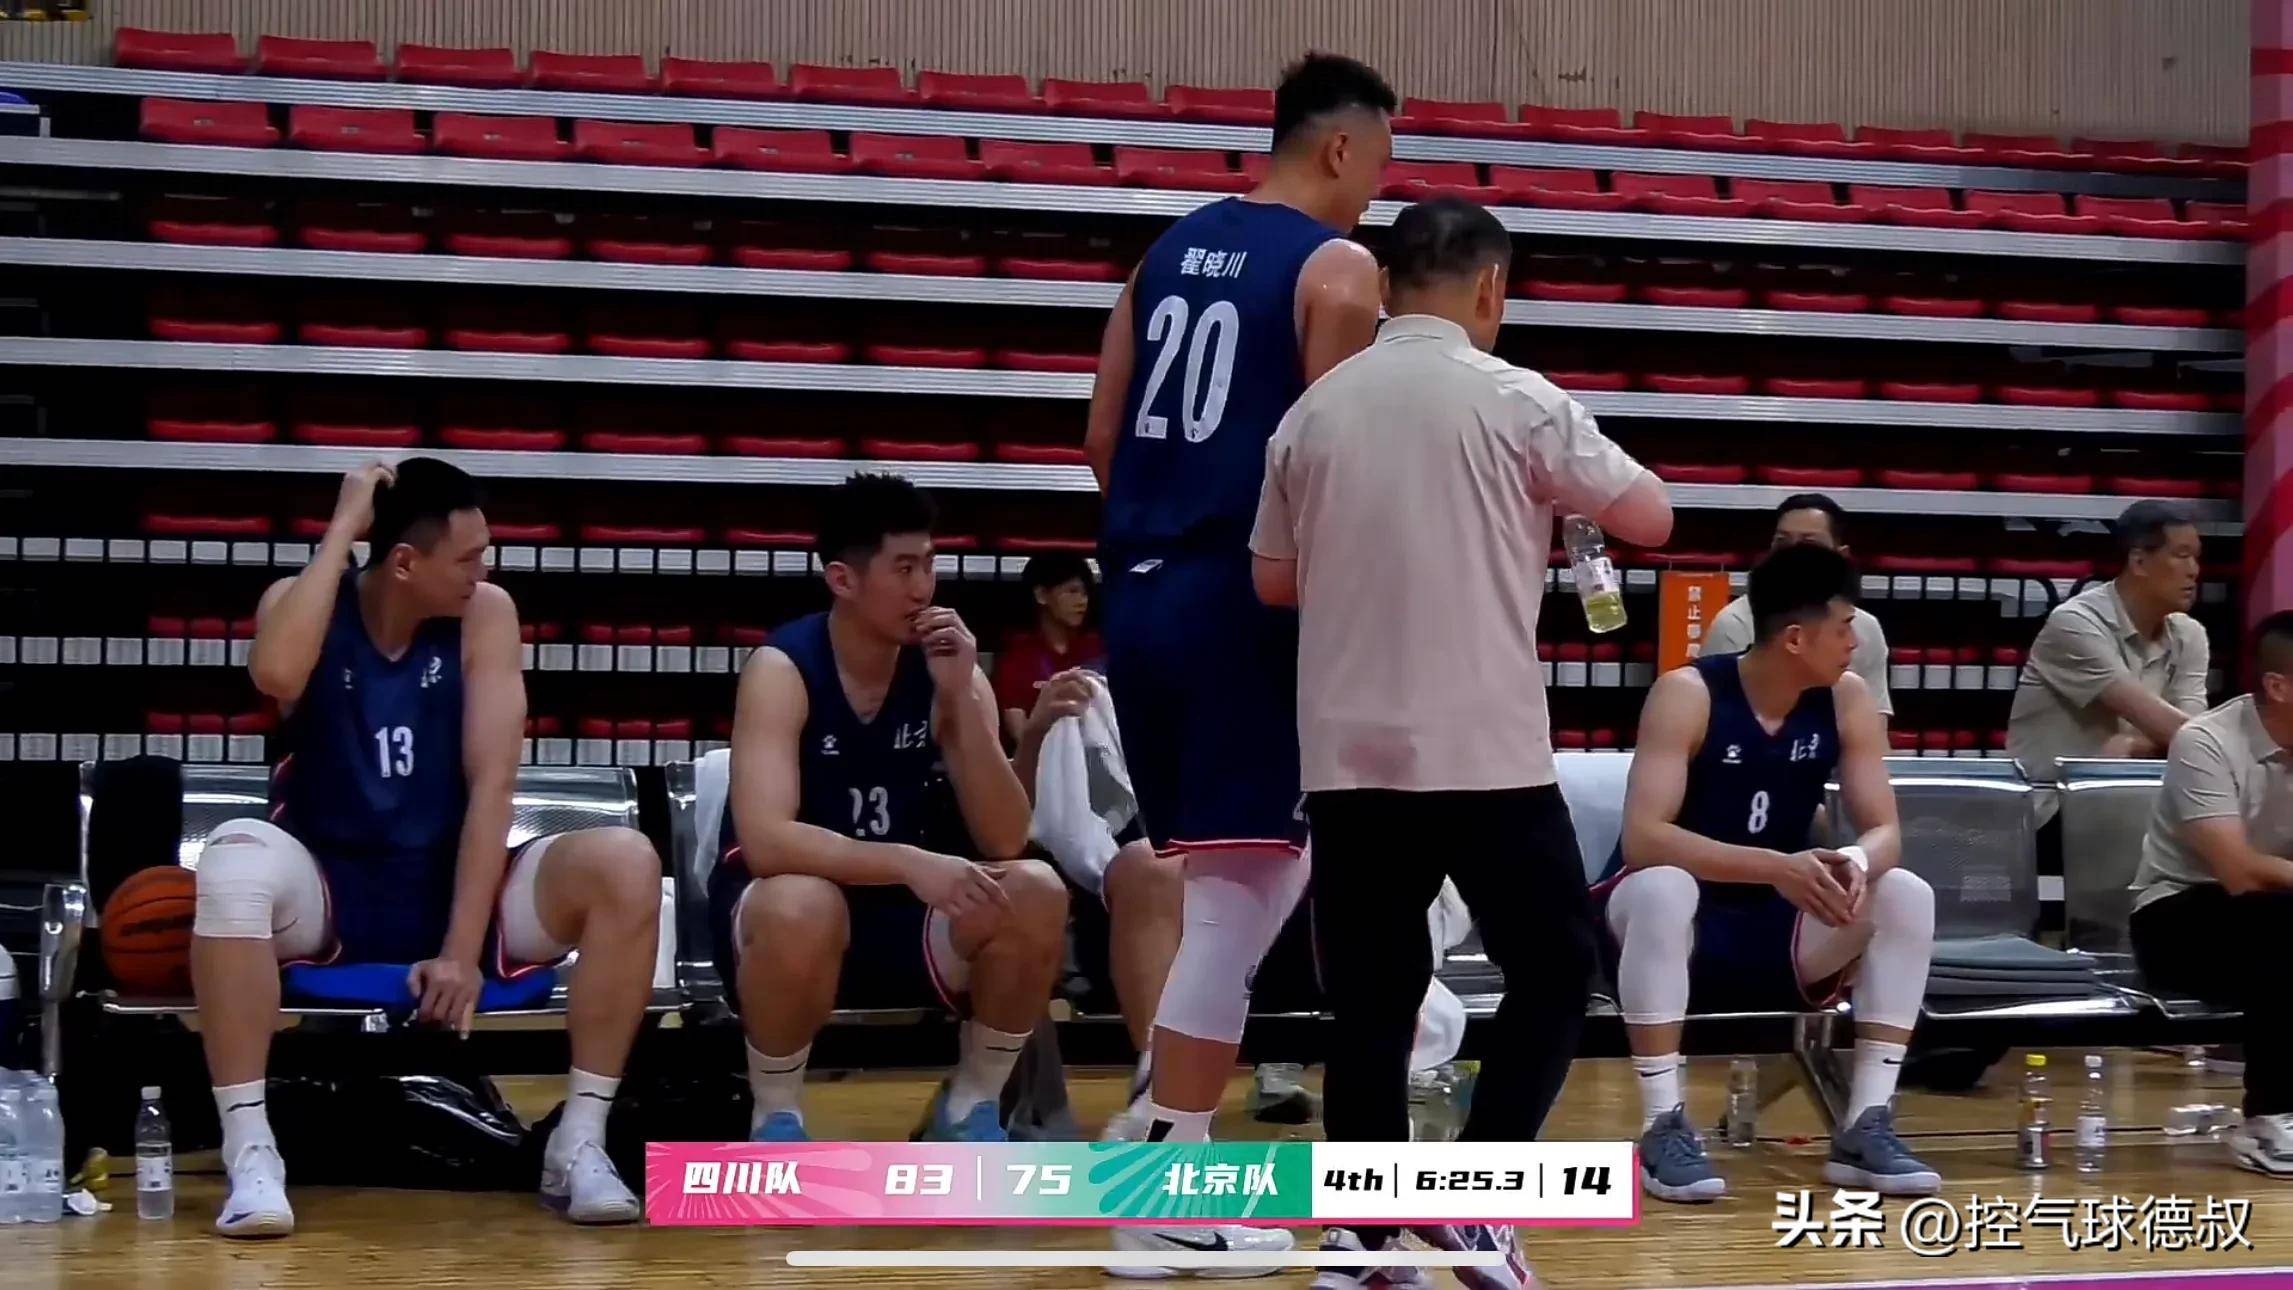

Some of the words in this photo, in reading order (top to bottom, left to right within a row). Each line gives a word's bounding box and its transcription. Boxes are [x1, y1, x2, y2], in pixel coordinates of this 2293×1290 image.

[1180, 247, 1247, 279] 翟晓川
[1135, 295, 1239, 443] 20
[374, 726, 414, 778] 13
[1747, 790, 1770, 834] 8
